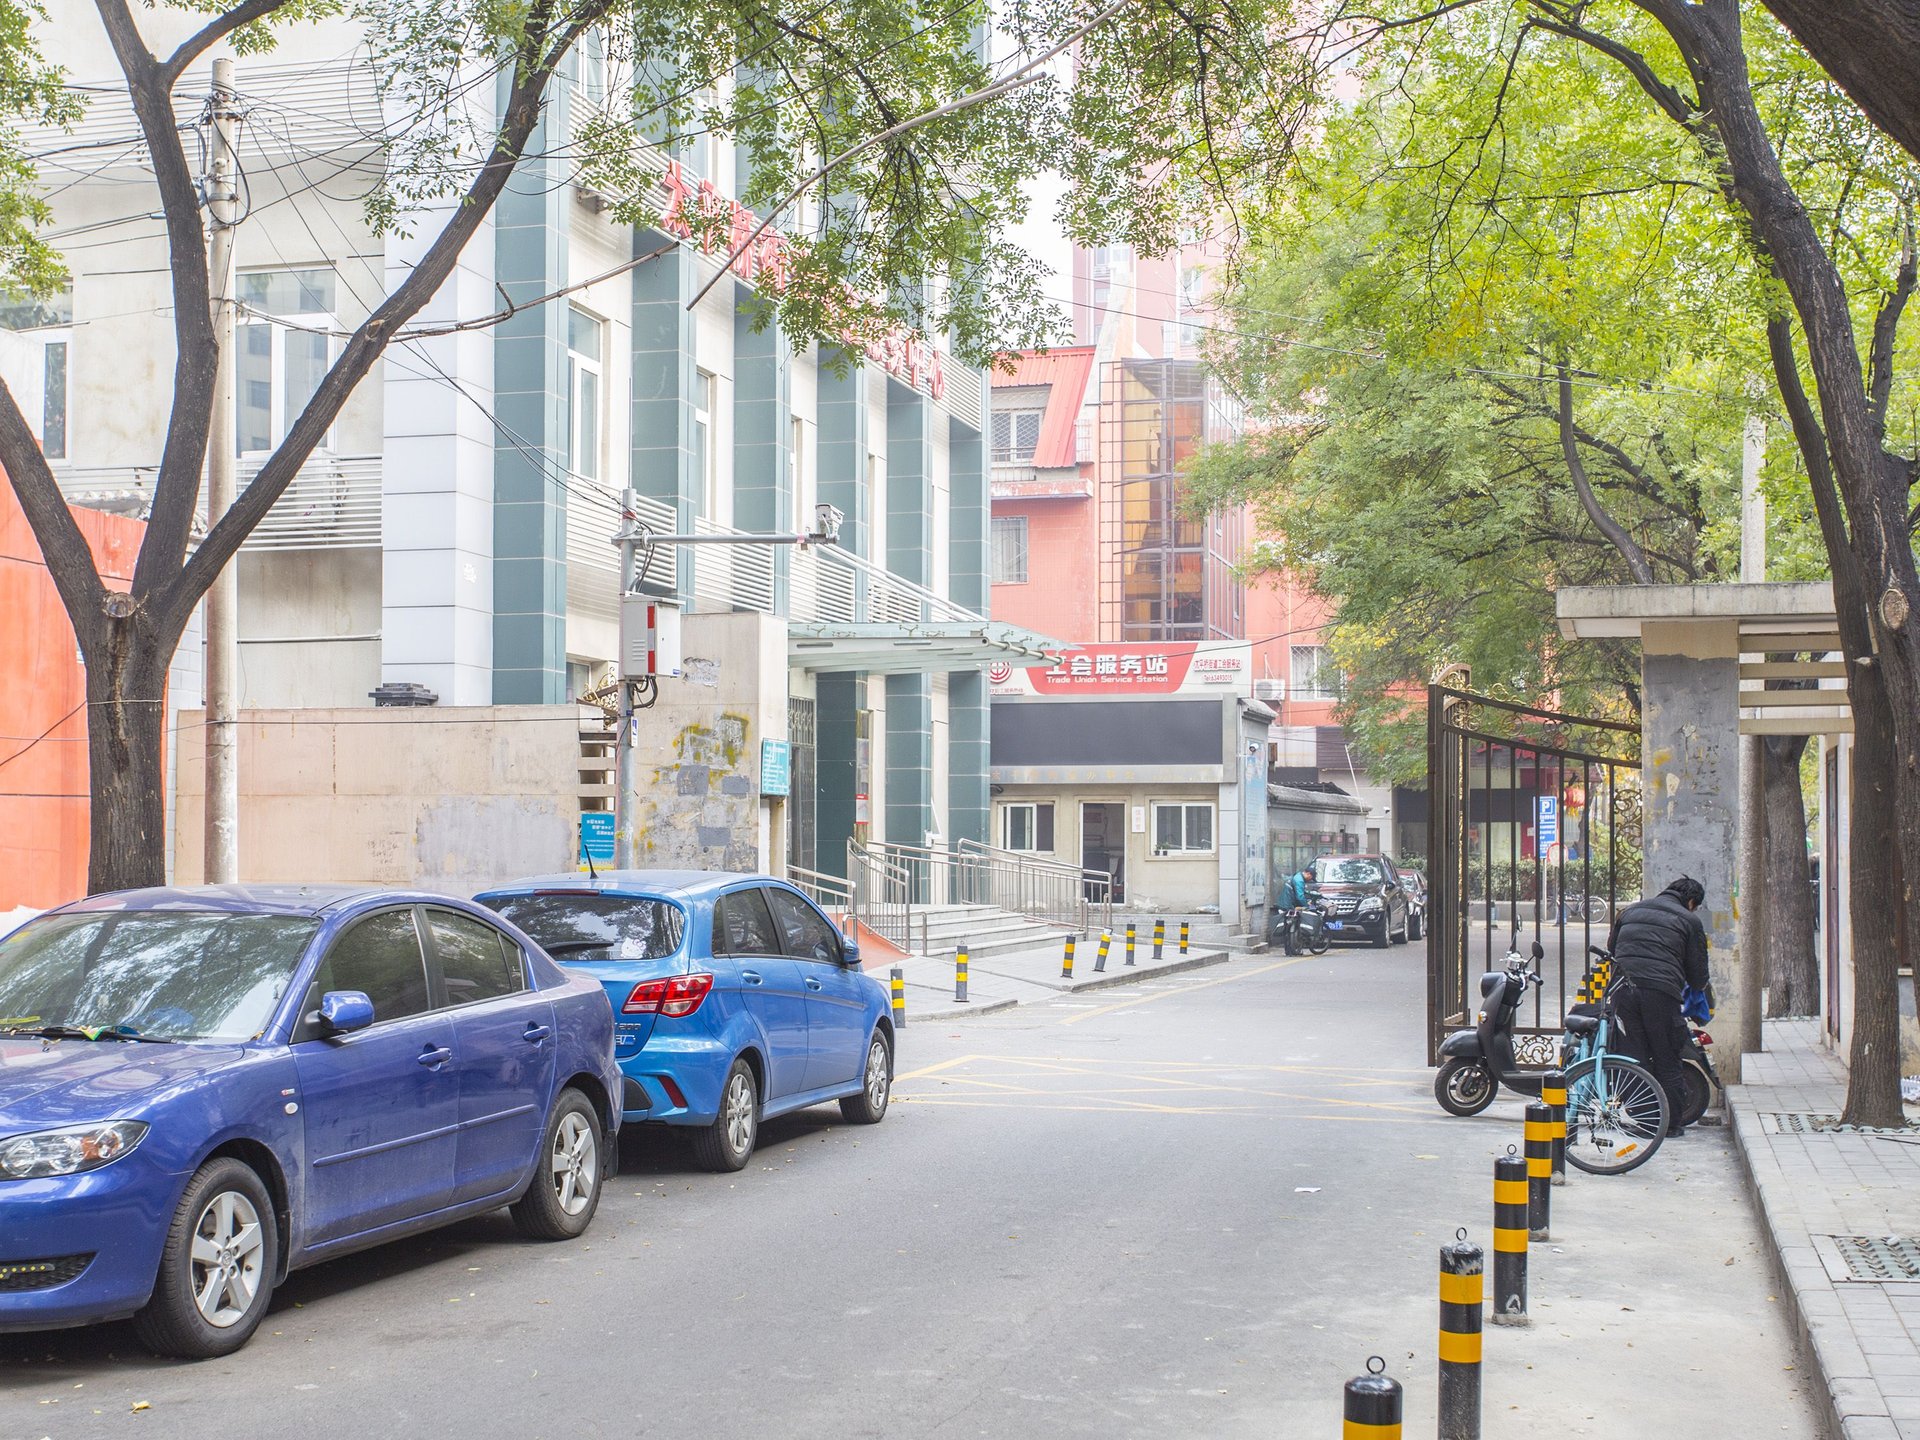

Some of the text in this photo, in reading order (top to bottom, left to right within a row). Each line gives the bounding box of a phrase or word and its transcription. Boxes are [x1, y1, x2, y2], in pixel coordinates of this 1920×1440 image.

[1045, 653, 1168, 676] 工会服务站
[1046, 675, 1168, 684] Trade Union Service Station
[1541, 800, 1551, 814] P
